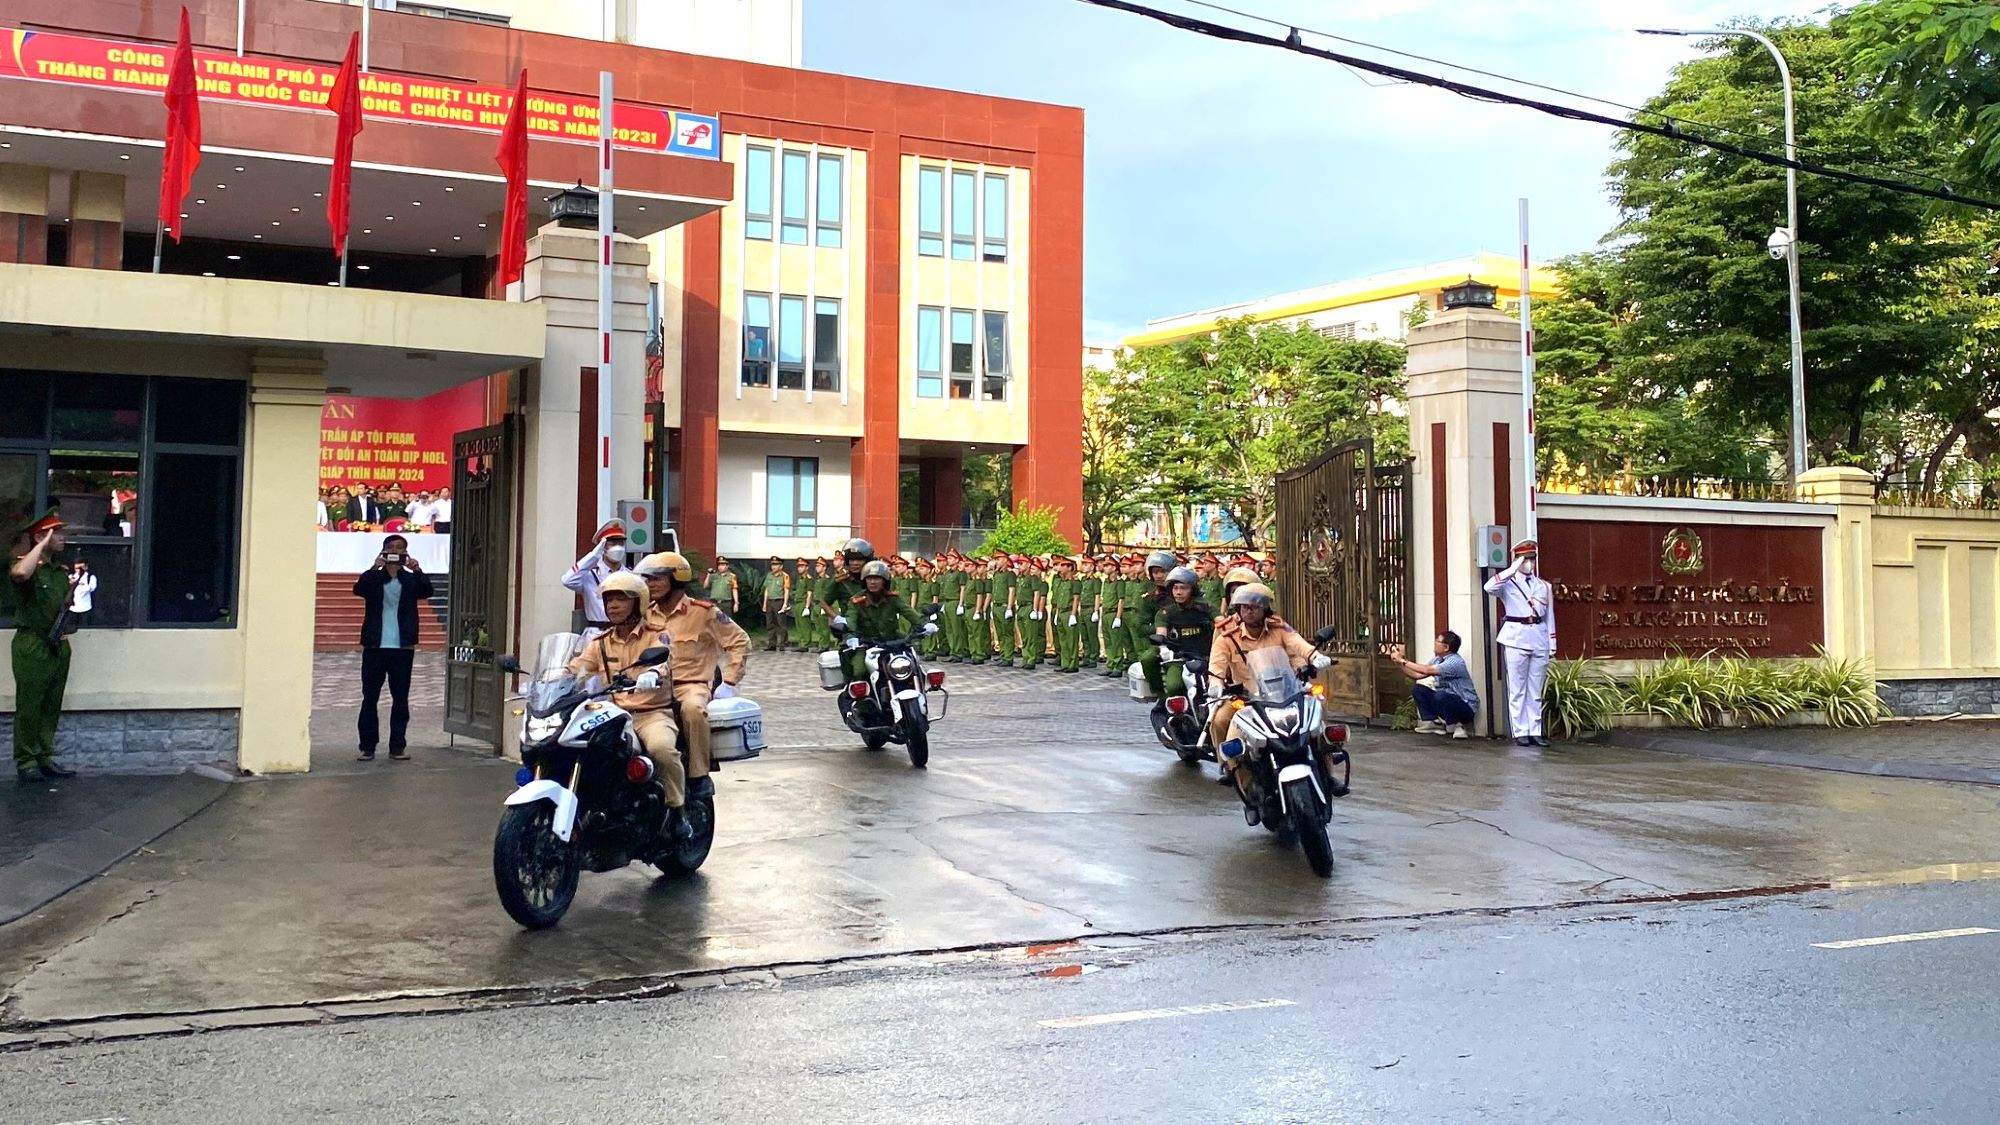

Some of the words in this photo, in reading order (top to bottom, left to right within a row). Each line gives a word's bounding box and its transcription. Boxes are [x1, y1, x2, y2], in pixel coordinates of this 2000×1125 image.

[107, 48, 165, 68] CÔNG
[204, 60, 270, 80] THÀNH
[276, 68, 316, 85] PHỐ
[321, 73, 336, 87] Đ
[409, 84, 462, 103] NHIỆT
[467, 90, 502, 109] LIỆT
[36, 60, 107, 81] THÁNG
[113, 69, 169, 88] HÀNH
[238, 82, 293, 101] QUỐC
[411, 100, 474, 122] CHỐNG
[565, 121, 600, 138] NĂM
[612, 127, 657, 145] 2023!
[366, 429, 383, 446] TỘI
[357, 448, 371, 462] AN
[373, 448, 400, 463] TOÀN
[373, 465, 396, 480] NĂM
[399, 469, 425, 481] 2024
[580, 711, 611, 732] CSGT
